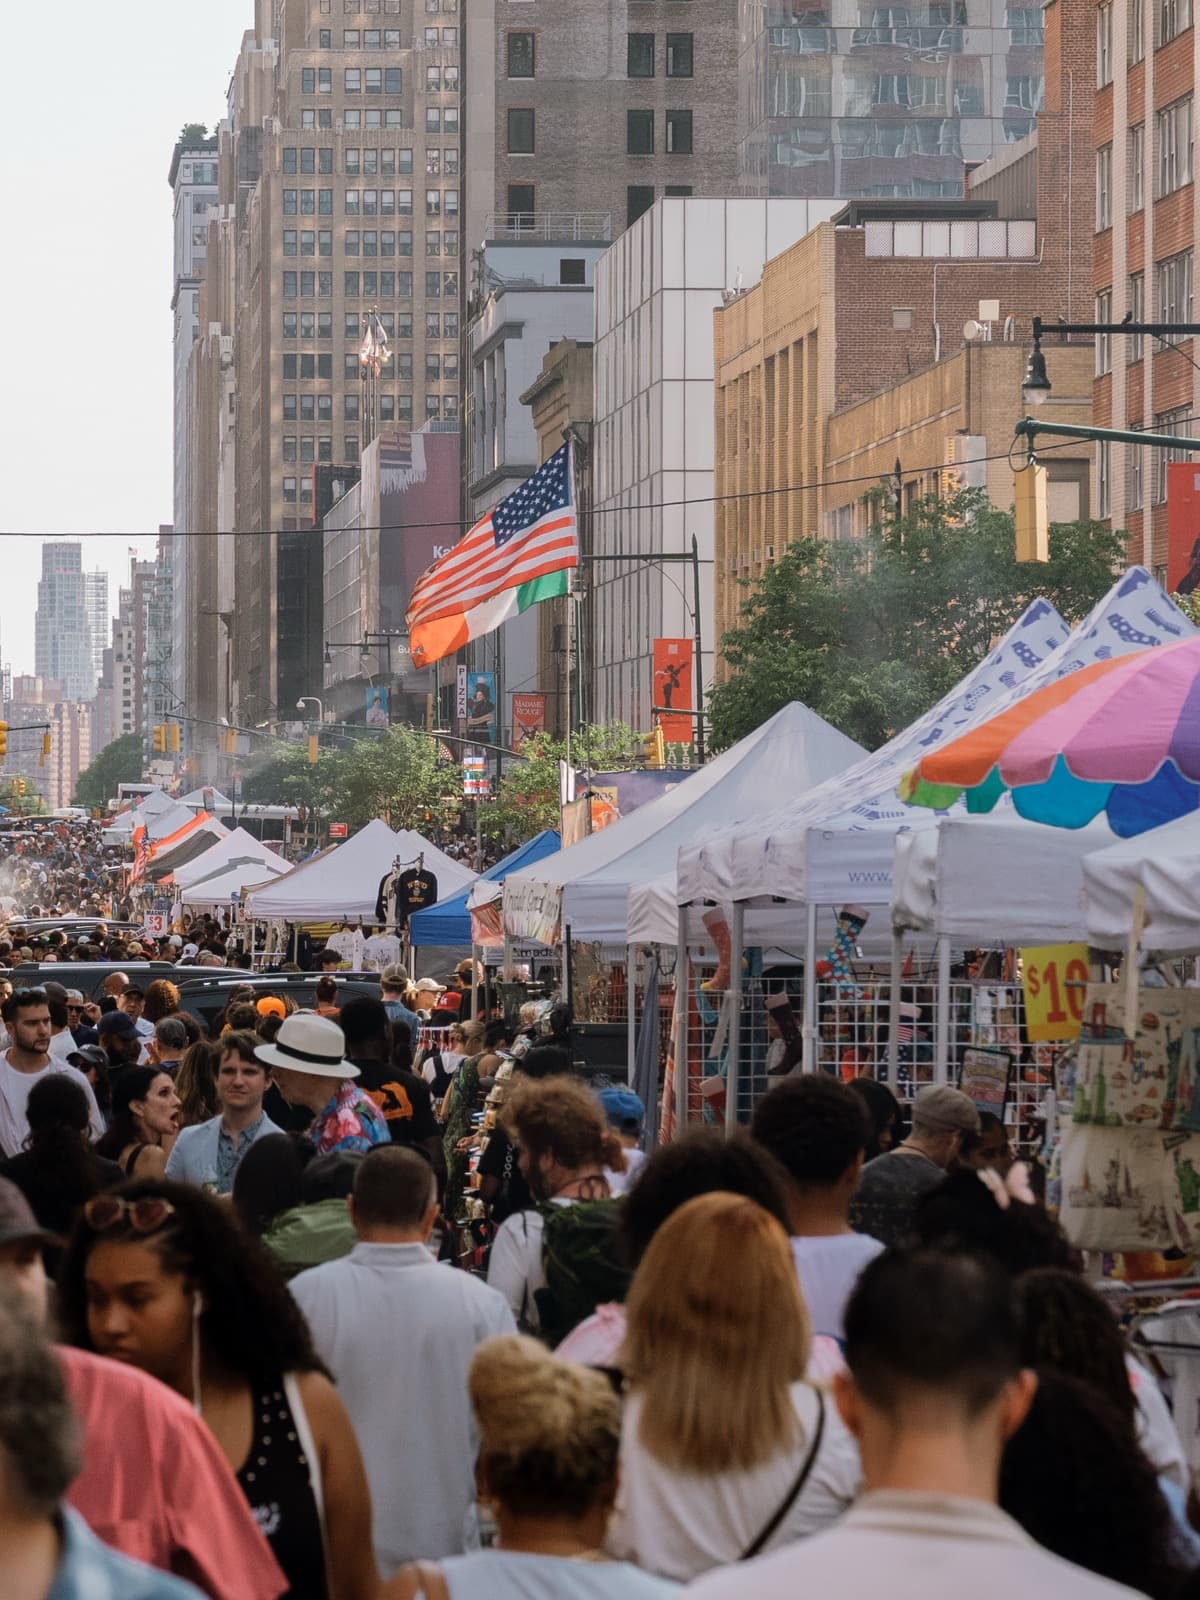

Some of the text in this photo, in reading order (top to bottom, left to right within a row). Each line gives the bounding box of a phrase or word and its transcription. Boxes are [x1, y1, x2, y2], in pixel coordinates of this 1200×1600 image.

[458, 668, 466, 715] PIZZA
[514, 700, 544, 708] MADAME
[516, 707, 540, 716] ROUGE
[149, 916, 163, 931] $3
[1026, 959, 1088, 1023] $10
